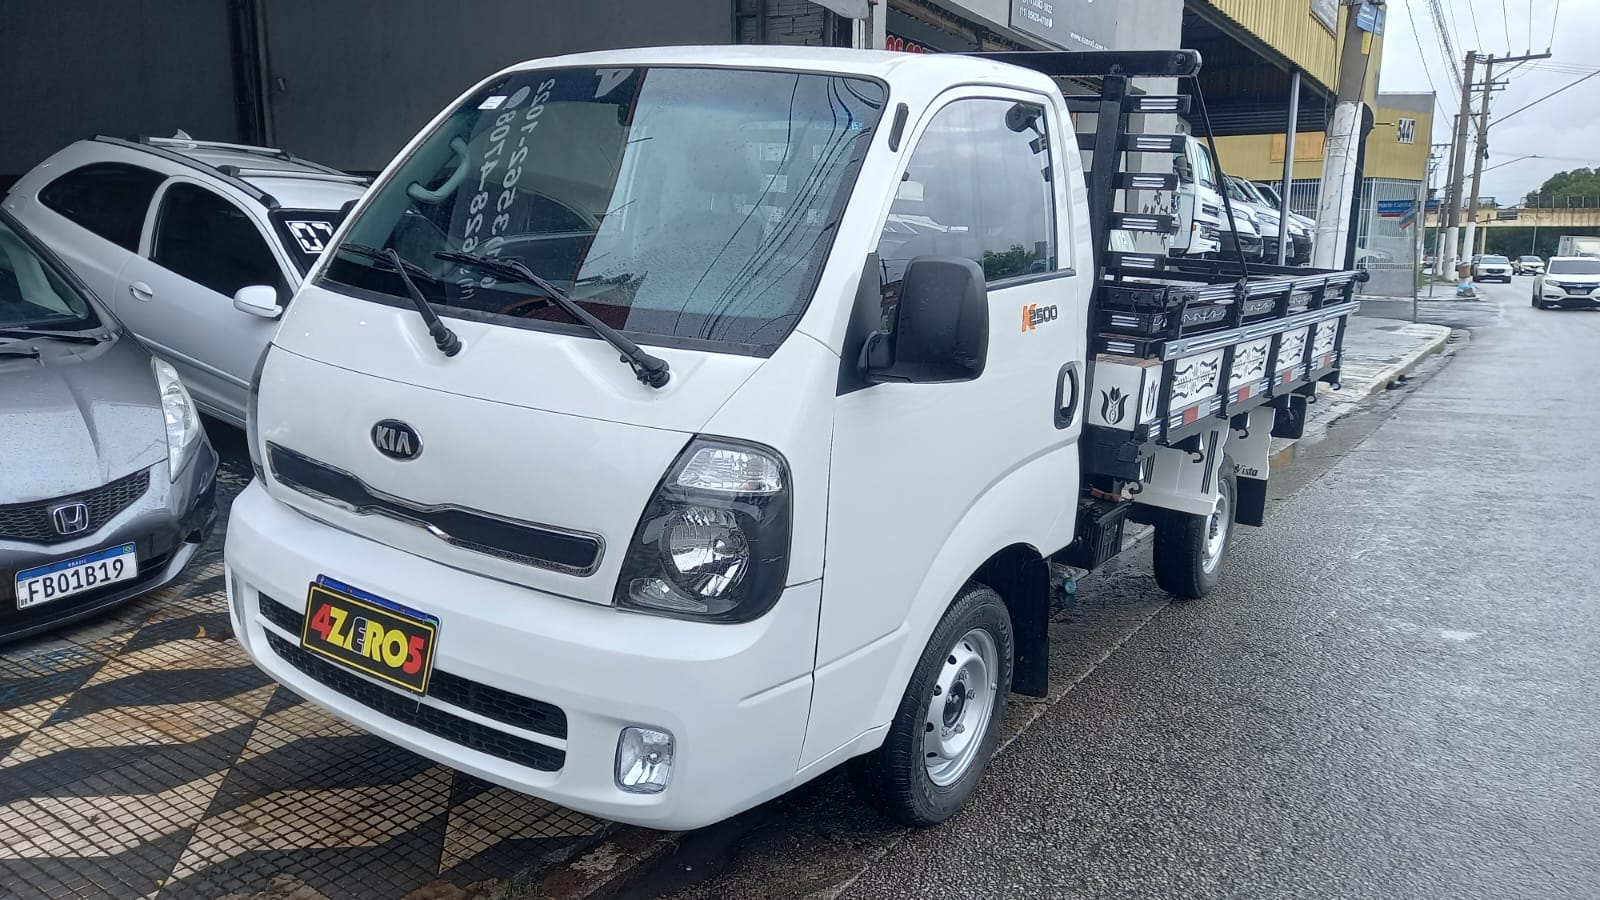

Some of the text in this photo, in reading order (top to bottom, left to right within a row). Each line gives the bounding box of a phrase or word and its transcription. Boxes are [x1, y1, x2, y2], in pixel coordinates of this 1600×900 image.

[1397, 119, 1415, 142] 5447
[376, 425, 412, 455] KIA
[311, 602, 425, 674] 4ZERO5
